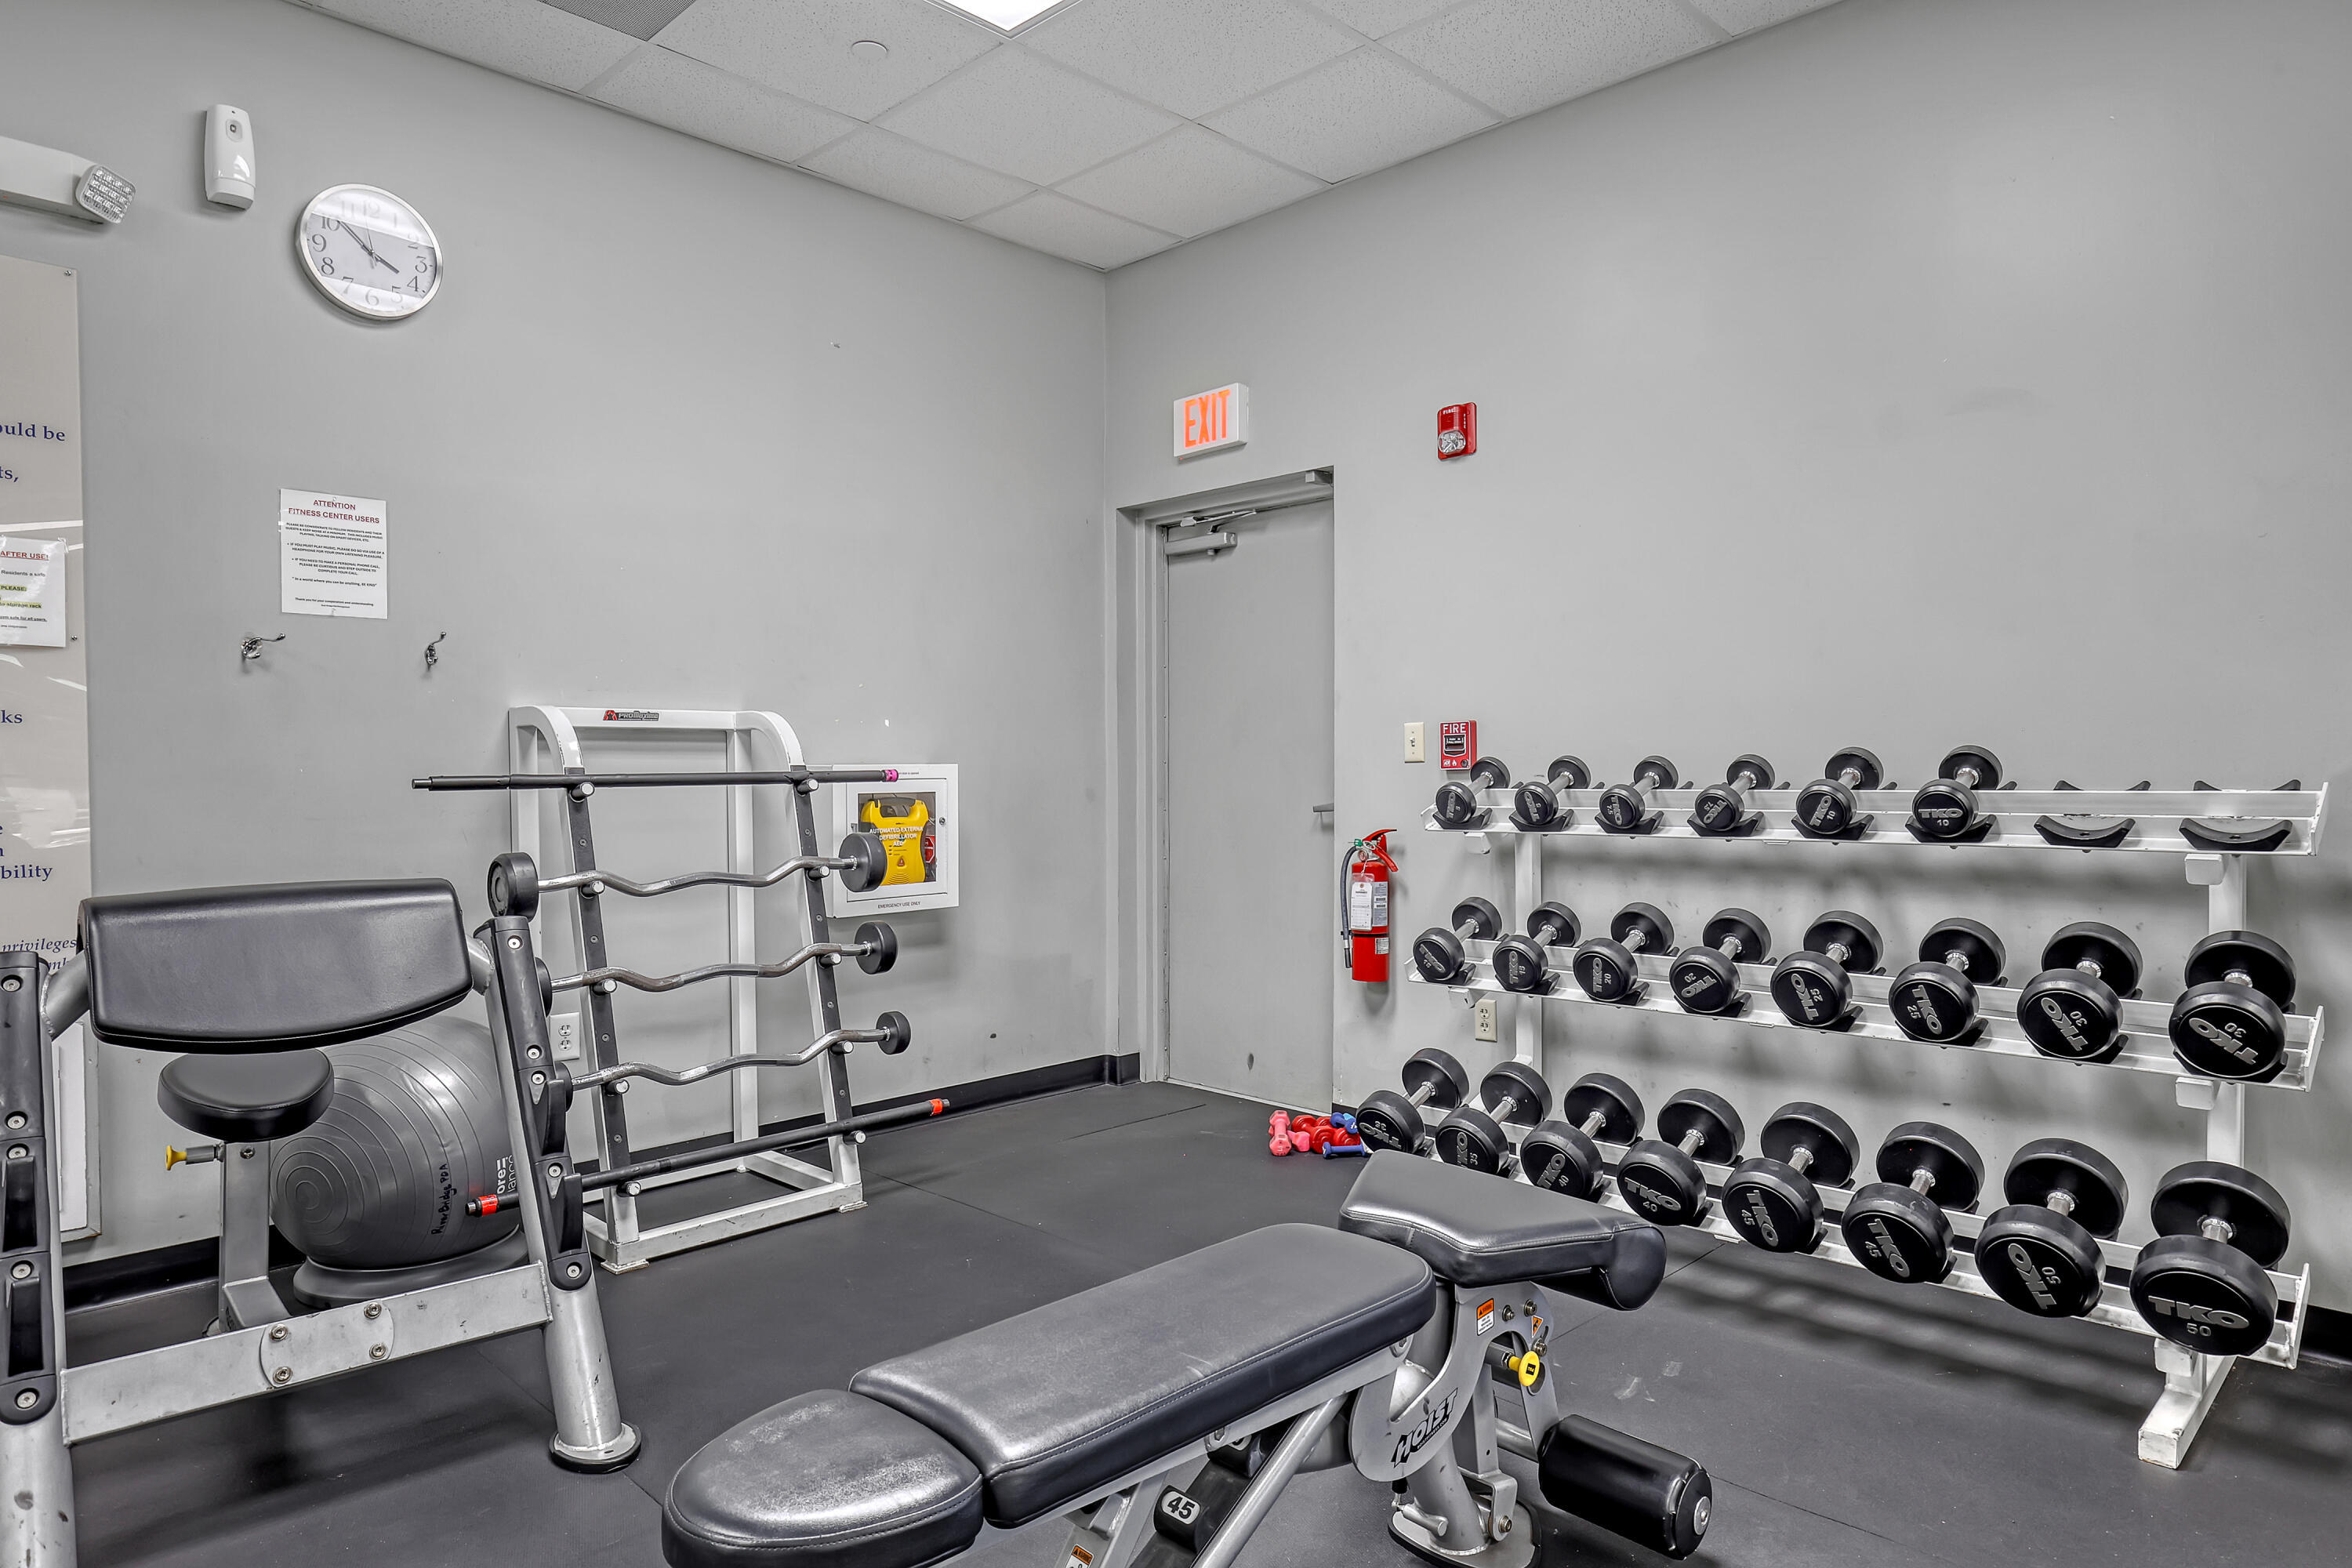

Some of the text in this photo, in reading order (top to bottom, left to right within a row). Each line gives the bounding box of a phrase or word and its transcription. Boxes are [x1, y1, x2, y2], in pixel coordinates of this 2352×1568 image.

[321, 216, 340, 231] 10
[312, 234, 327, 252] 9
[321, 257, 335, 274] 8
[415, 256, 427, 273] 3
[342, 277, 354, 294] 7
[407, 275, 419, 292] 4
[365, 289, 379, 306] 6
[391, 286, 403, 303] 5
[1184, 390, 1231, 448] EXIT
[0, 423, 65, 441] uld be
[314, 499, 356, 510] ATTENTION
[289, 507, 379, 524] FITNESS CENTER USERS
[1443, 724, 1466, 733] FIRE
[1524, 792, 1540, 822] TKO
[1611, 796, 1622, 826] TKO
[1704, 800, 1727, 824] TKO
[1809, 795, 1832, 826] TKO
[1826, 811, 1836, 820] 10
[1918, 808, 1963, 818] TKO
[1419, 944, 1445, 973] TKO
[1508, 951, 1518, 984] TKO
[1592, 957, 1602, 993] TKO
[1604, 973, 1611, 985] 20
[1684, 973, 1697, 982] 20
[1682, 975, 1717, 998] TKO
[1791, 973, 1819, 1020] TKO
[1810, 989, 1823, 1002] 25
[1907, 1005, 1921, 1019] 25
[1912, 985, 1942, 1034] TKO
[2041, 997, 2088, 1051] TKO
[2070, 1011, 2088, 1026] 30
[2224, 1022, 2246, 1037] 30
[2189, 1018, 2258, 1065] TKO
[1359, 1122, 1402, 1149] TKO
[1470, 1152, 1479, 1166] 35
[1537, 1153, 1566, 1189] TKO
[1559, 1175, 1569, 1187] 40
[1624, 1178, 1681, 1210] TKO
[1642, 1201, 1657, 1212] 40
[1741, 1210, 1755, 1225] 45
[1747, 1190, 1779, 1247] TKO
[1865, 1241, 1882, 1258] 45
[1867, 1218, 1910, 1277] TKO
[2008, 1243, 2056, 1309] TKO
[2042, 1267, 2061, 1284] 50
[2148, 1295, 2249, 1329] TKO
[2187, 1323, 2211, 1337] 50
[1391, 1387, 1458, 1468] HOIST
[1167, 1497, 1195, 1519] 45
